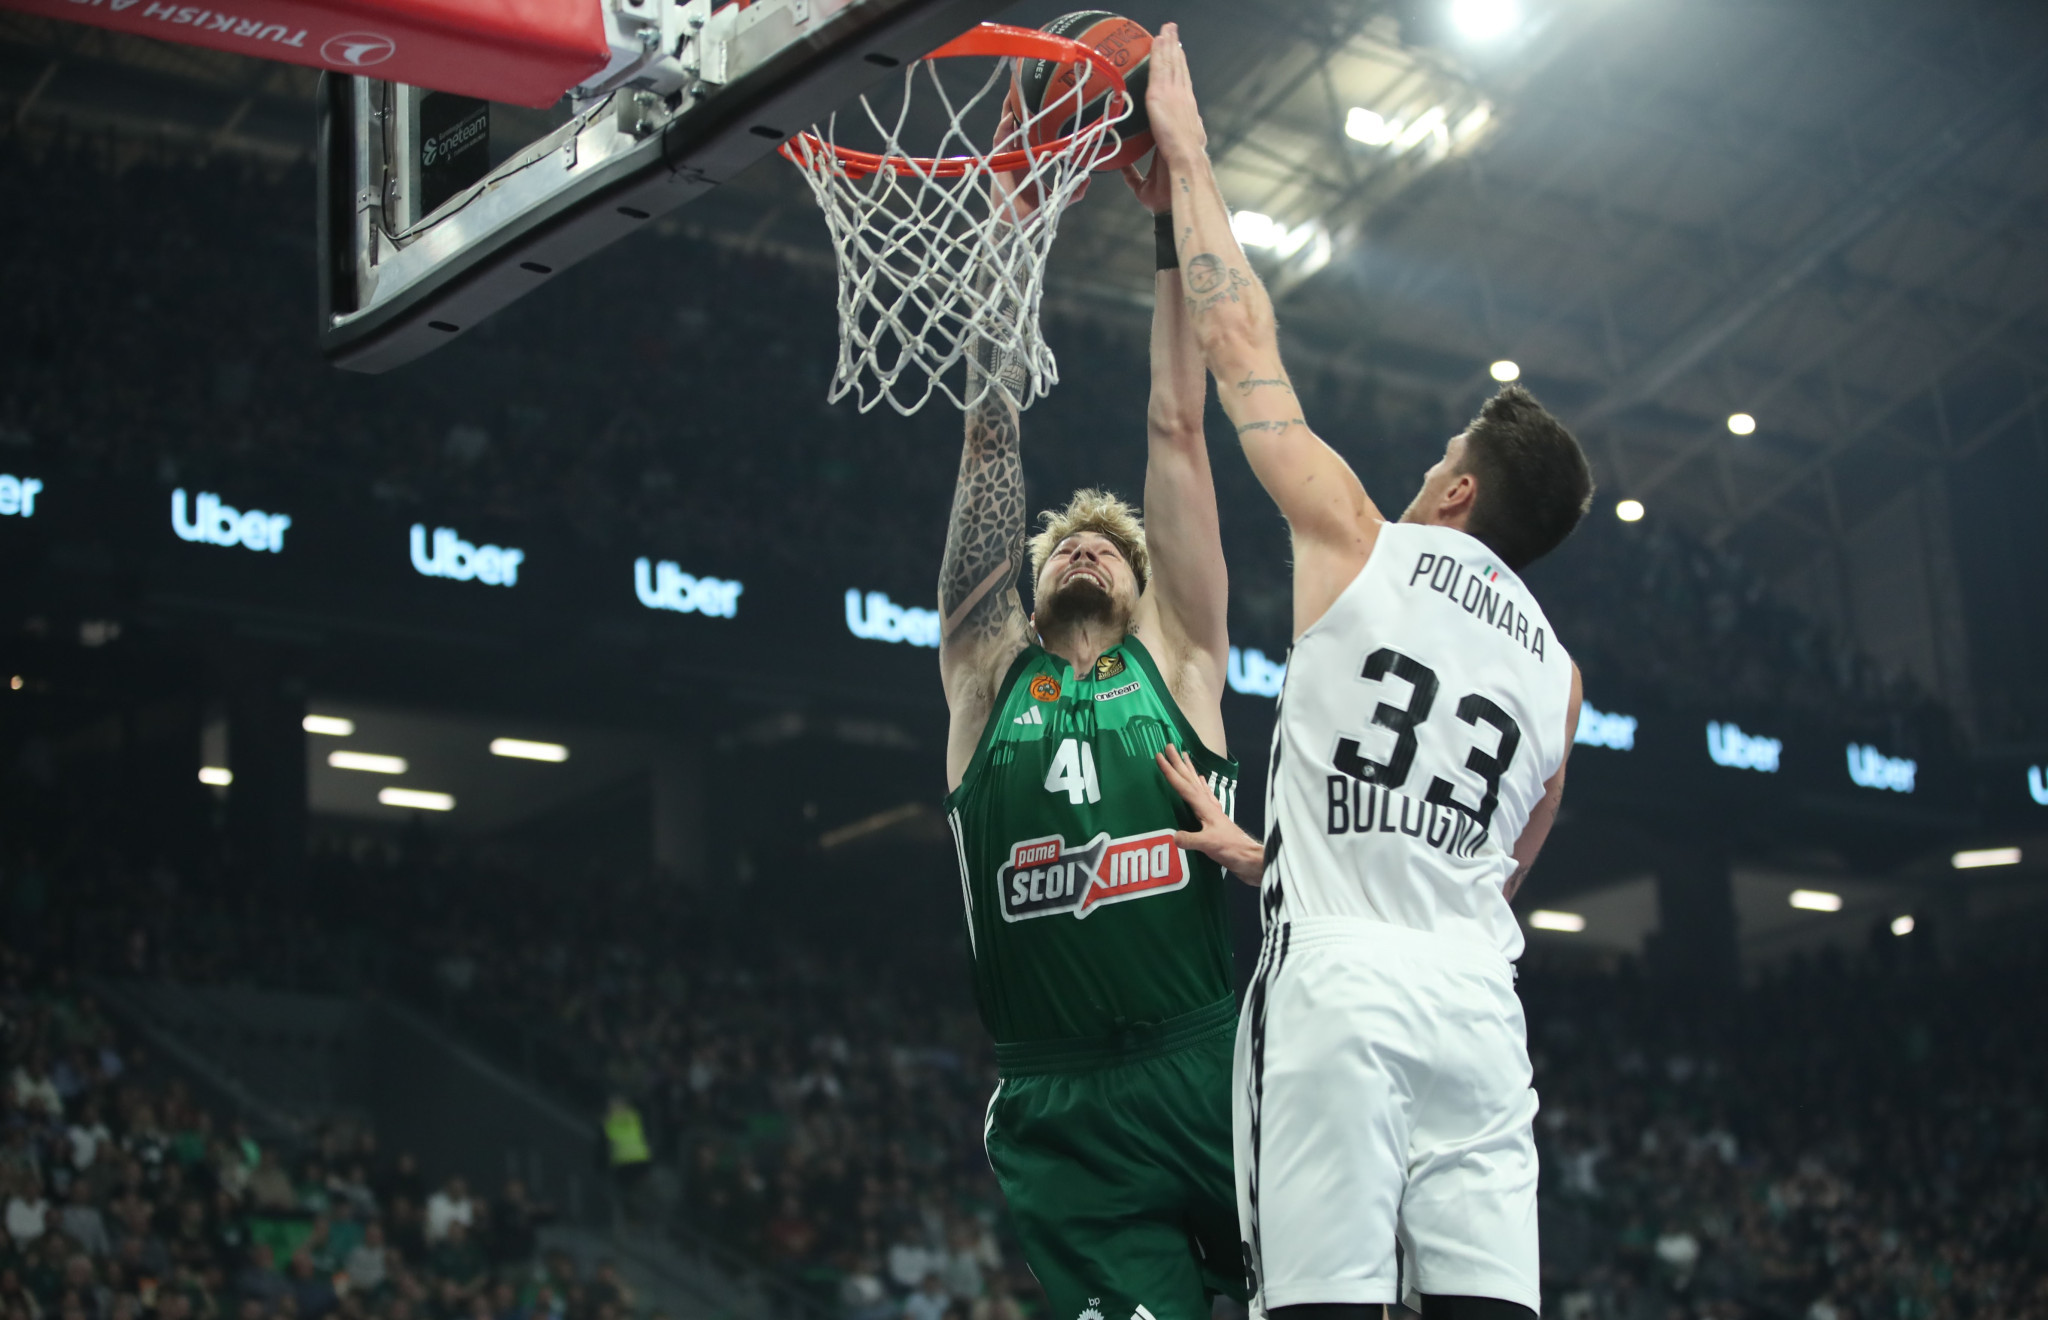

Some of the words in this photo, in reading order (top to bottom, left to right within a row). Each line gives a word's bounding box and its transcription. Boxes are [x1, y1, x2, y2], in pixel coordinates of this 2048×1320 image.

[142, 2, 308, 48] TURKISH
[438, 115, 487, 156] oneteam
[0, 473, 43, 517] er
[171, 487, 291, 553] Uber
[409, 522, 525, 588] Uber
[634, 556, 743, 619] Uber
[1409, 552, 1545, 663] POLONARA
[1095, 682, 1140, 700] oneteam
[1331, 646, 1522, 832] 33
[1574, 699, 1638, 751] ber
[1706, 719, 1783, 773] Uber
[1043, 738, 1102, 805] 41
[1846, 741, 1918, 793] Uber
[1018, 843, 1056, 867] pame
[1088, 1297, 1101, 1307] bp
